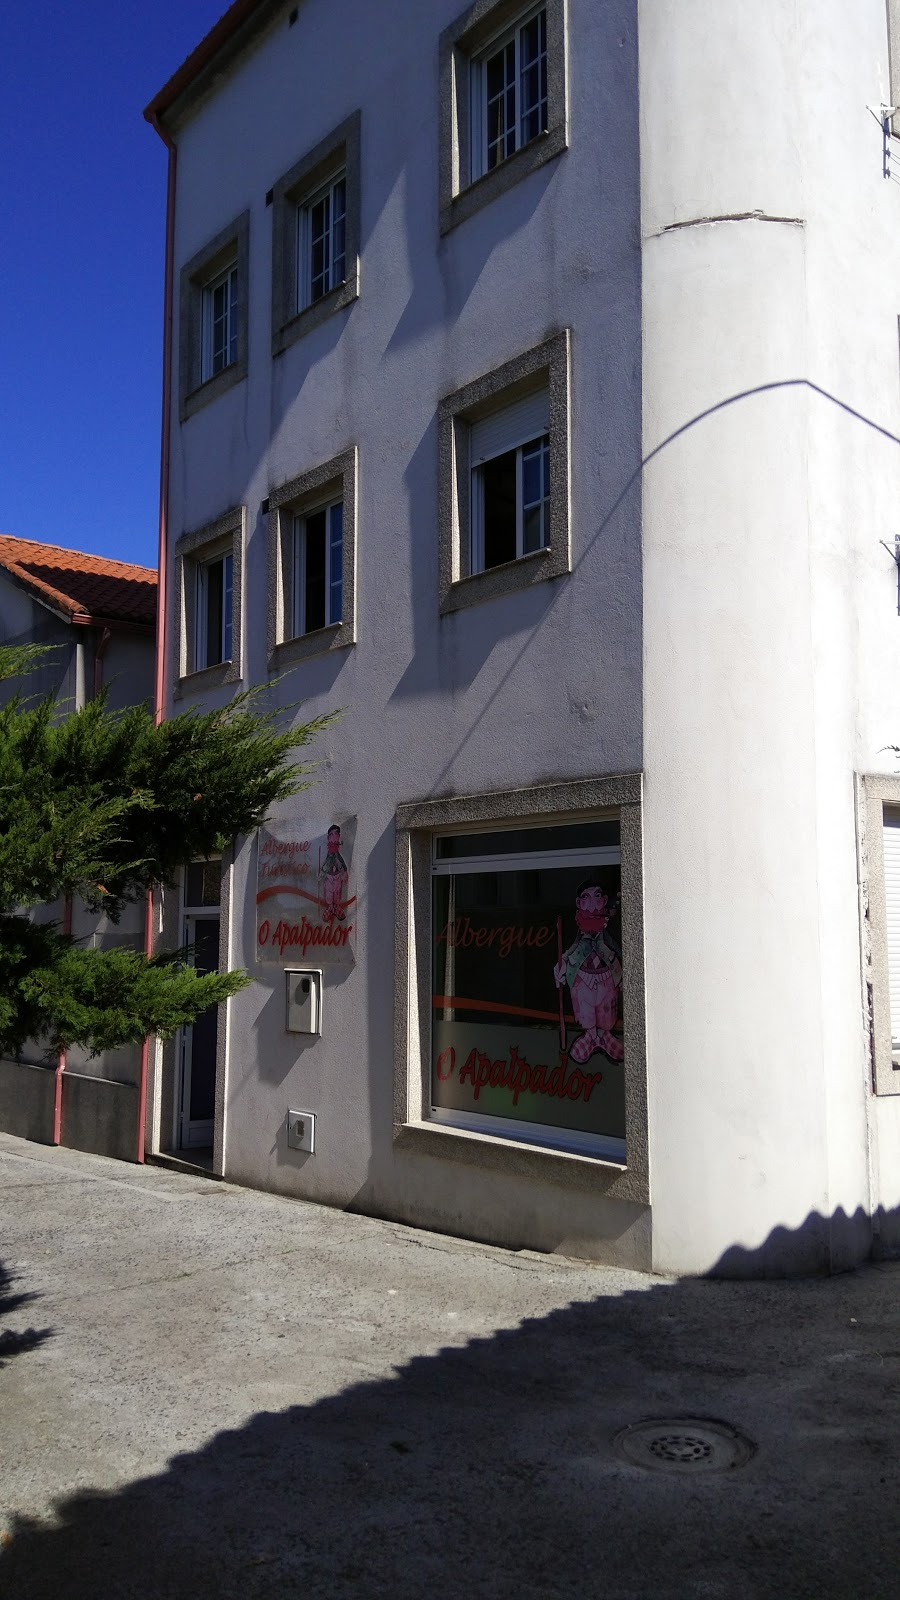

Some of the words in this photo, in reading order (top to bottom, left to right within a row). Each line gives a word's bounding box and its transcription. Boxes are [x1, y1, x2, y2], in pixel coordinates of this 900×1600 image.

[260, 838, 311, 858] Albergue
[258, 919, 270, 946] O
[272, 916, 352, 956] Apalpador
[437, 916, 554, 958] Albergue
[436, 1047, 456, 1081] O
[459, 1045, 602, 1106] Apalpador
